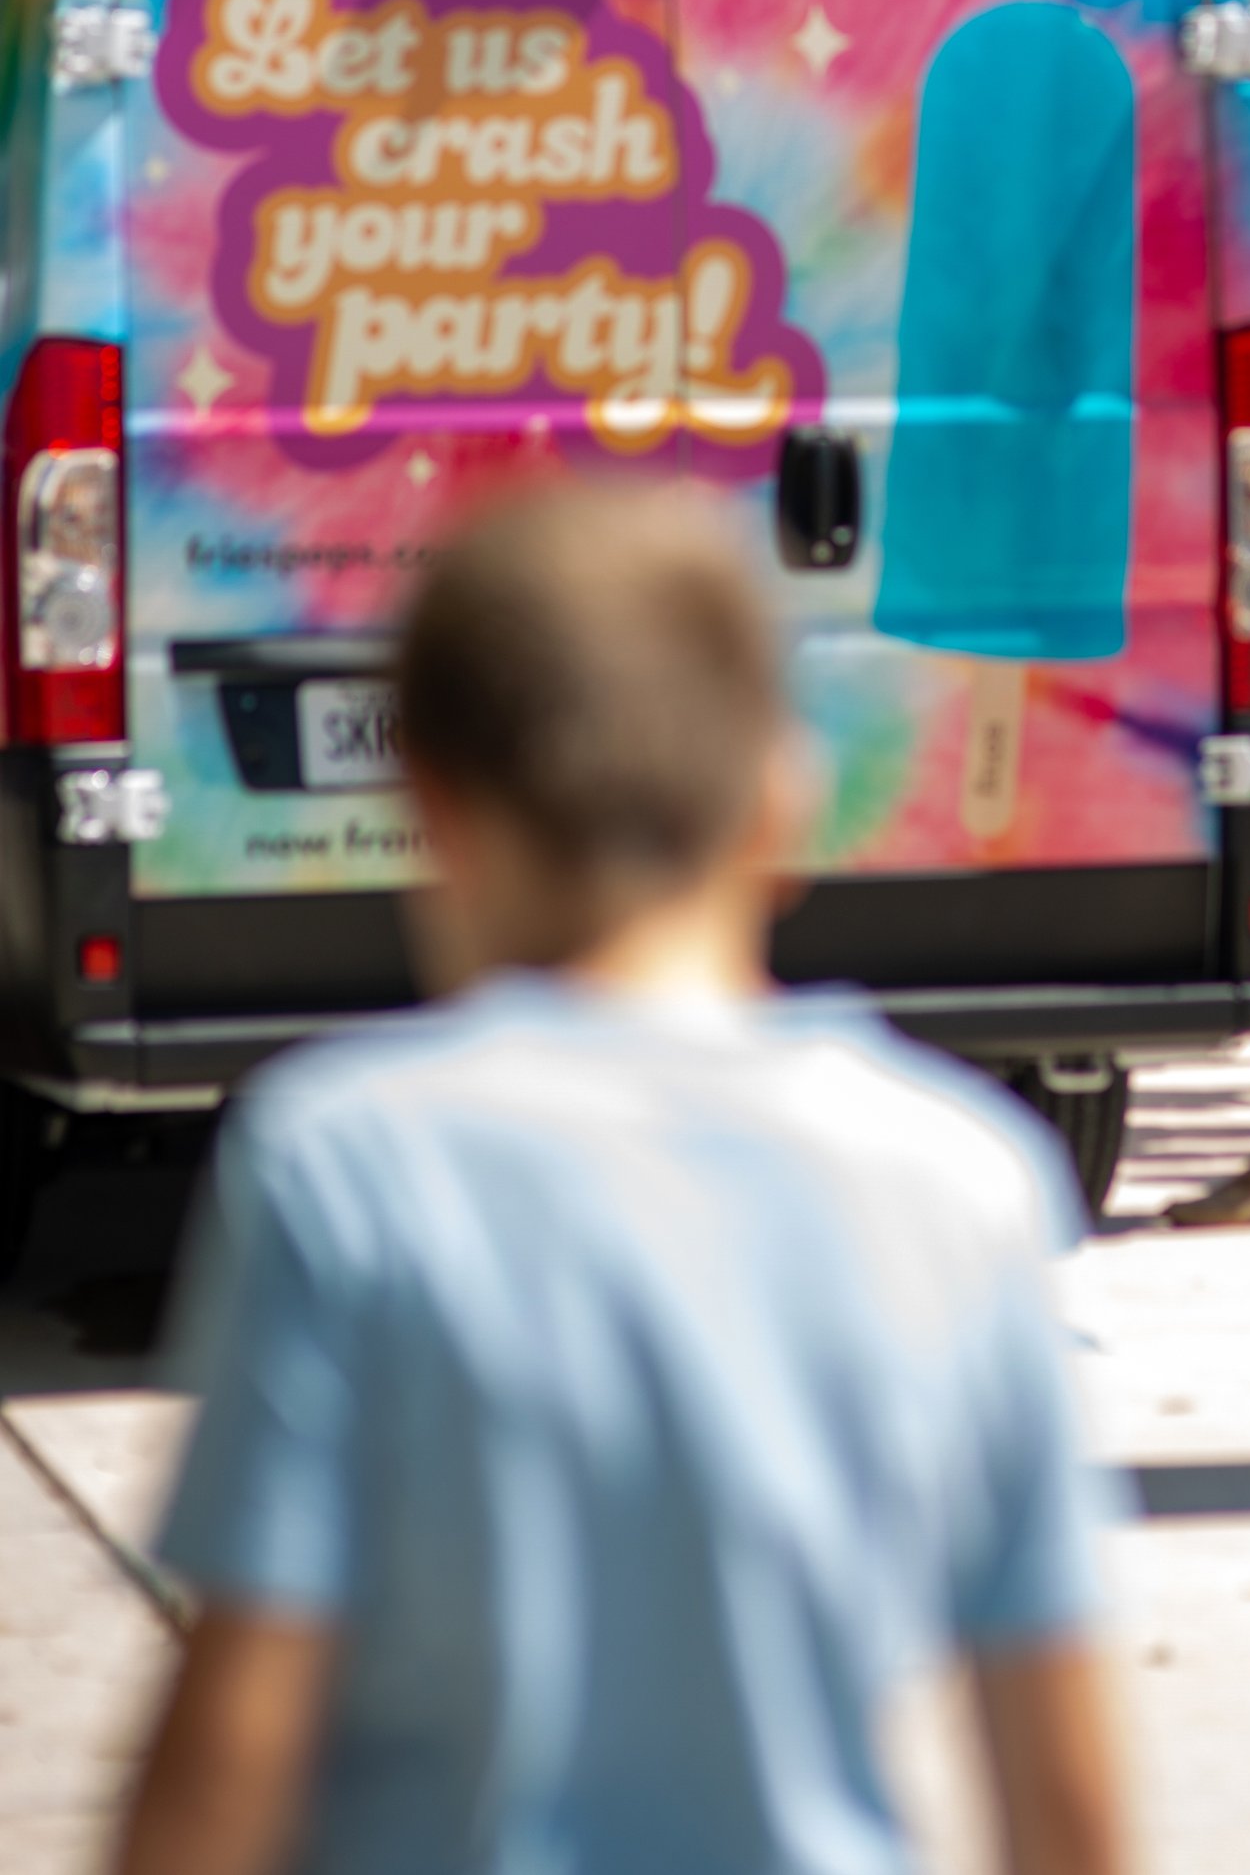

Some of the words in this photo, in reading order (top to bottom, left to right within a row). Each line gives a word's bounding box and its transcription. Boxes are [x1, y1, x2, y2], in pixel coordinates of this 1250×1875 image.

[444, 25, 572, 95] us
[350, 73, 667, 186] crash
[264, 200, 526, 307] your
[321, 257, 780, 432] party!
